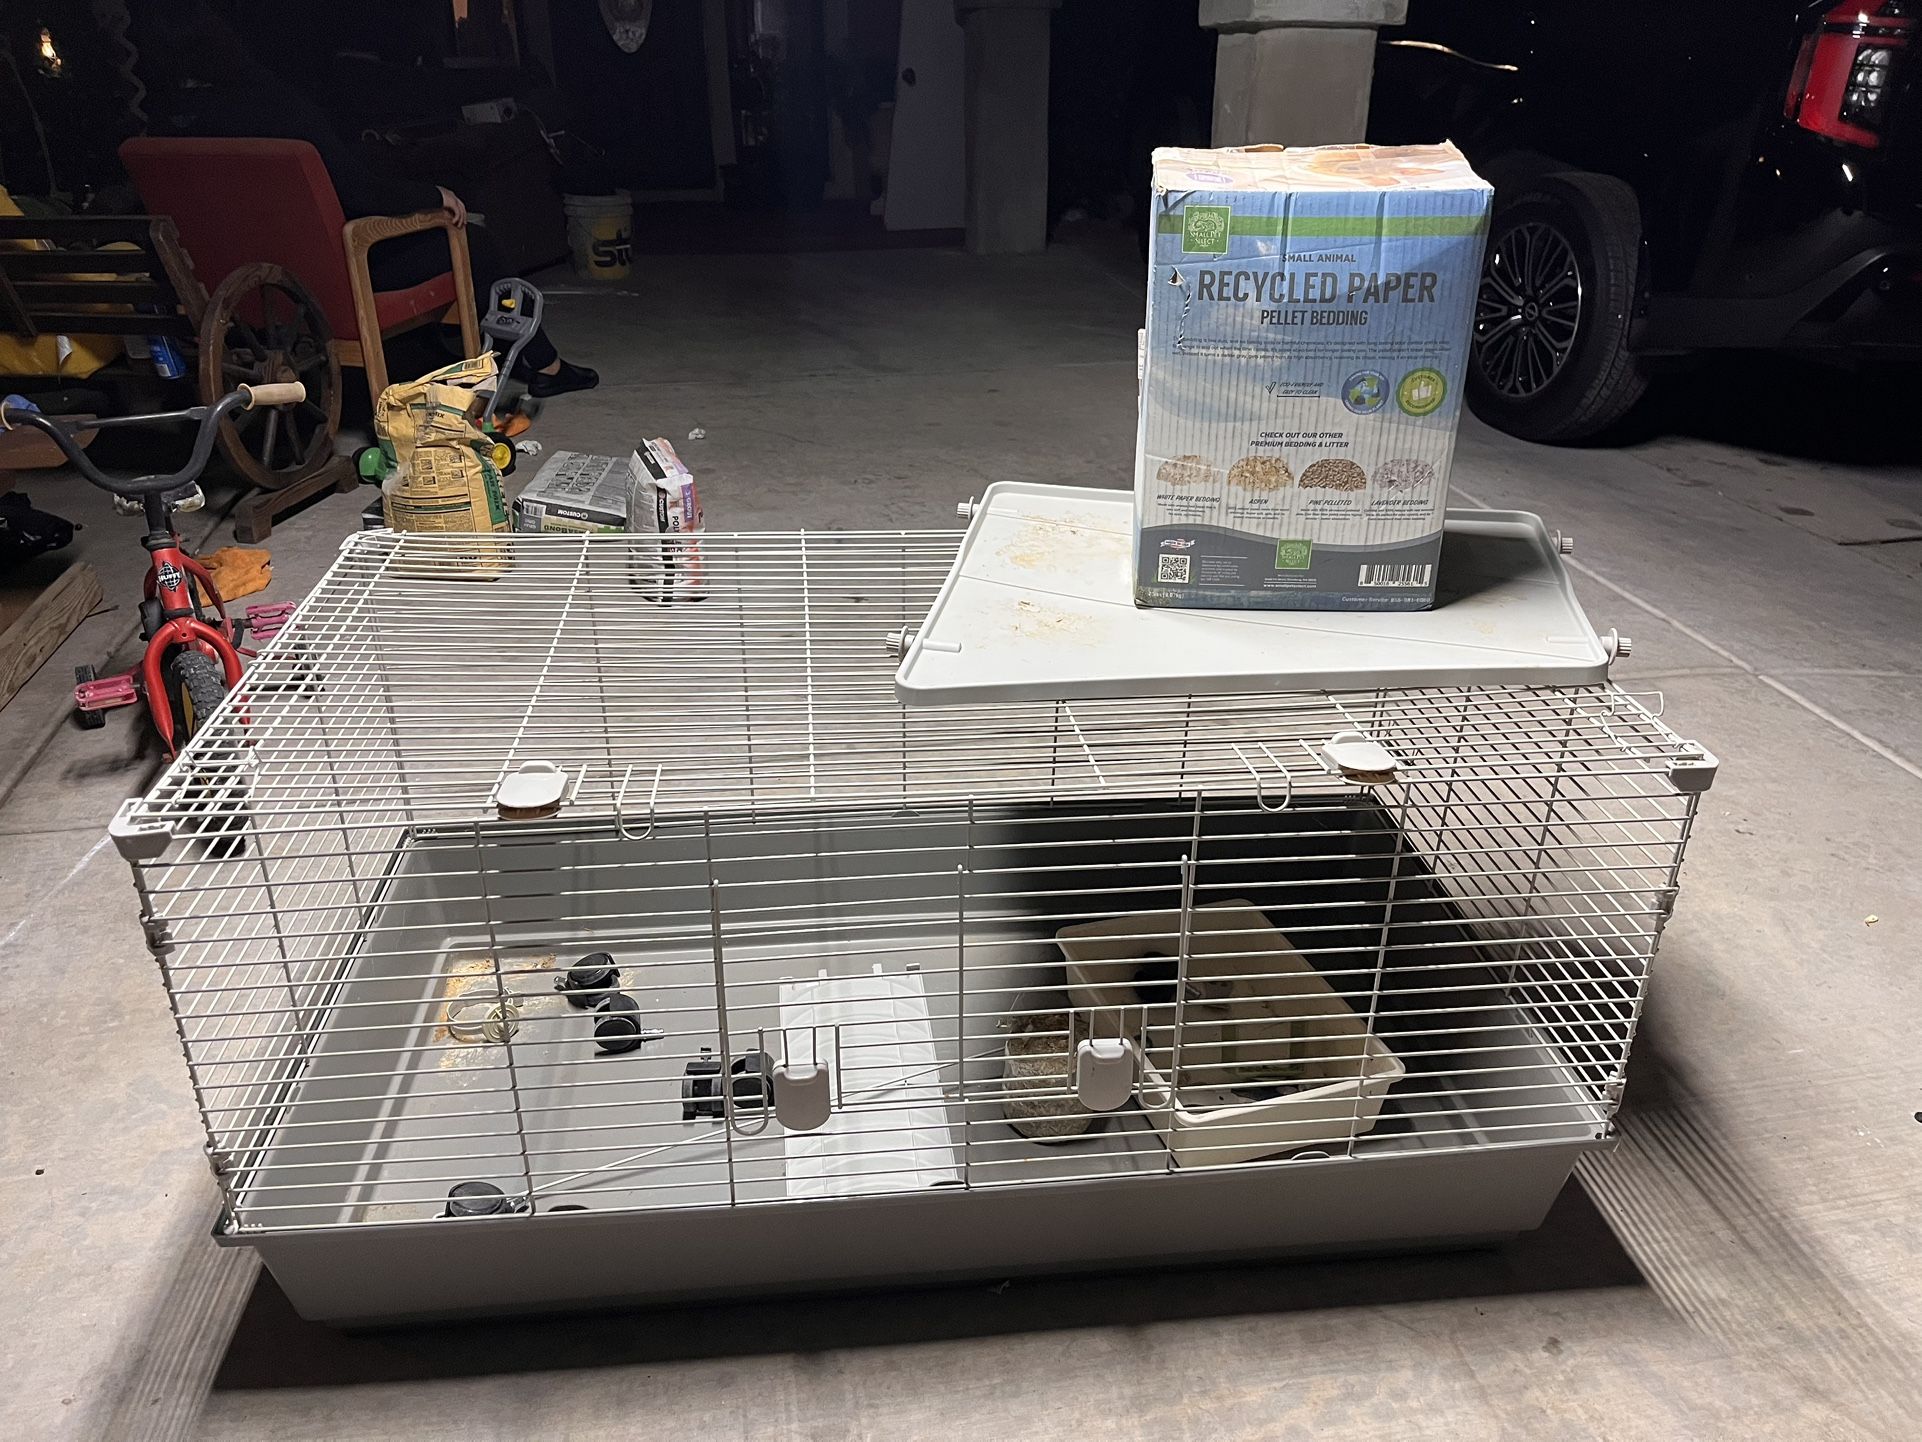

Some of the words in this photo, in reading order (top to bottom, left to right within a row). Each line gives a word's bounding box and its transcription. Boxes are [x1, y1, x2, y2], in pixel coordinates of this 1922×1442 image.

[1281, 253, 1314, 263] SMALL
[1317, 253, 1357, 263] ANIMAL
[1197, 269, 1338, 304] RECYCLED
[1347, 271, 1438, 304] PAPER
[1260, 309, 1308, 325] PELLET
[1310, 310, 1369, 326] BEDDING
[1259, 431, 1285, 439] CHECK
[1285, 431, 1301, 439] OUT
[1301, 431, 1318, 439] OUR
[1318, 431, 1344, 439] OTHER
[1250, 440, 1284, 448] PREMIUM
[557, 508, 581, 518] CUSTOM
